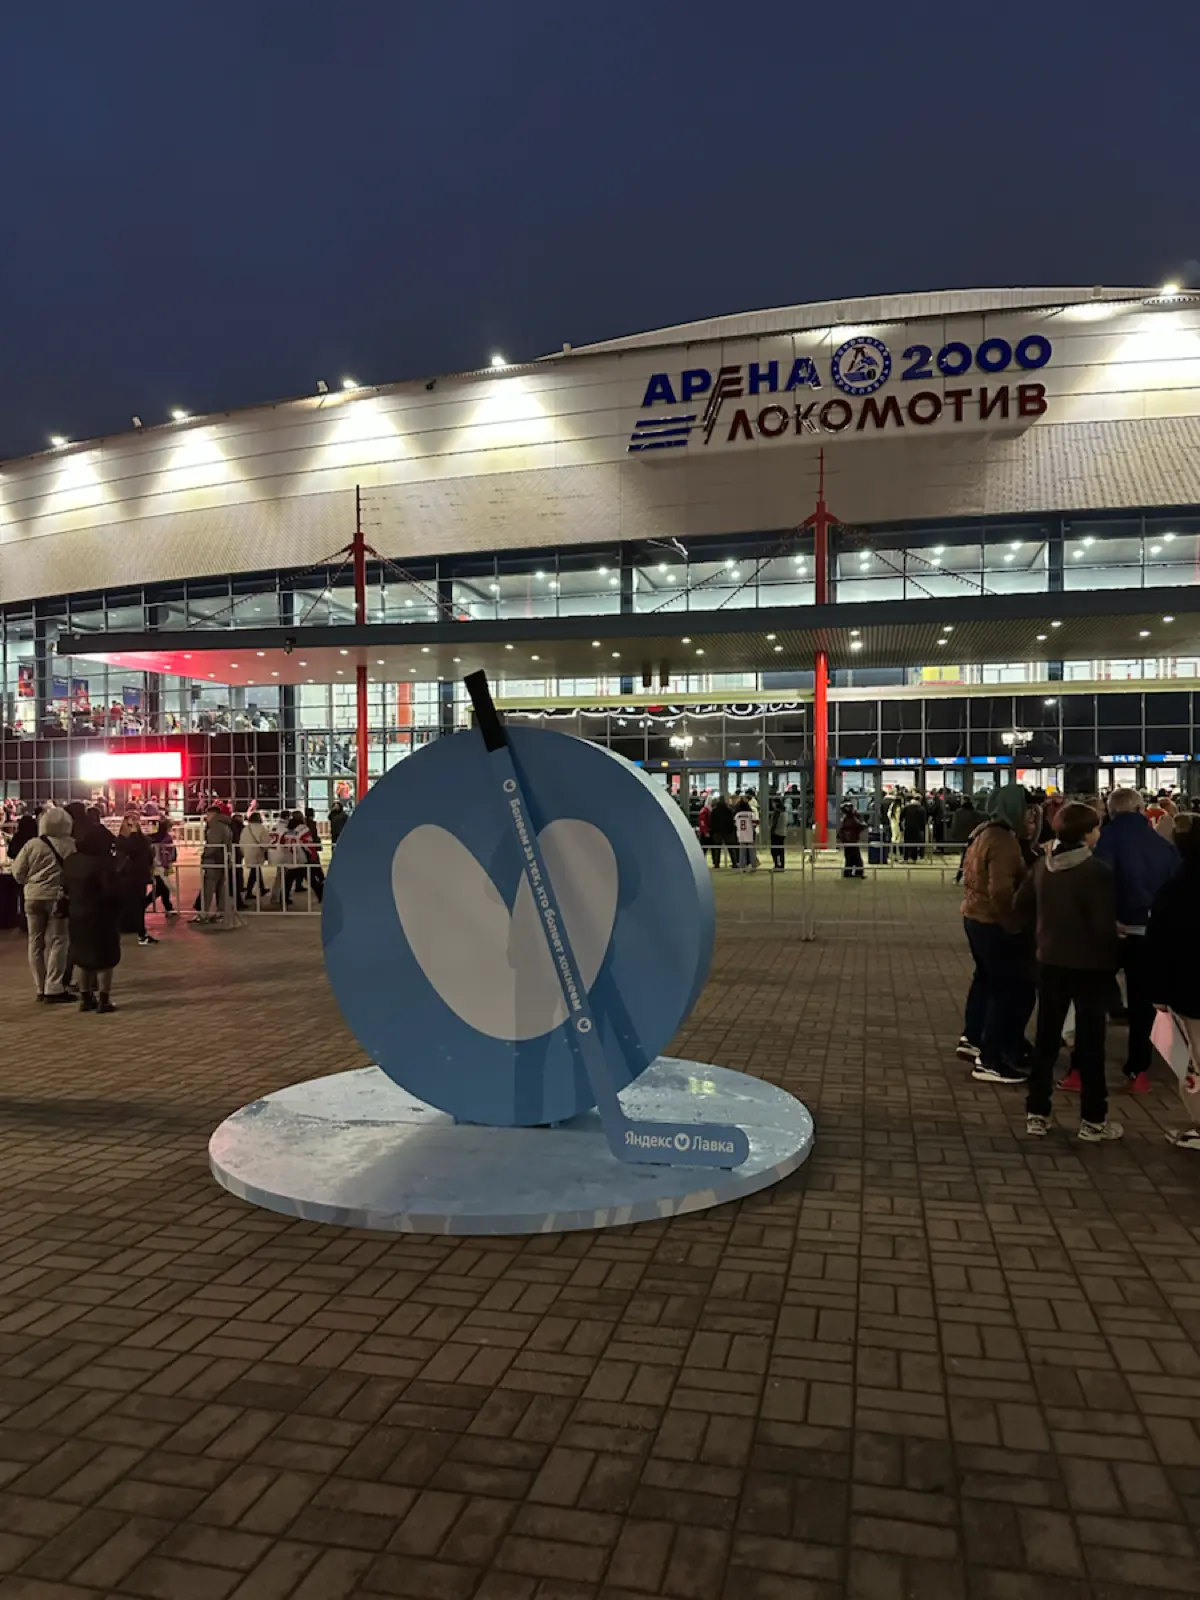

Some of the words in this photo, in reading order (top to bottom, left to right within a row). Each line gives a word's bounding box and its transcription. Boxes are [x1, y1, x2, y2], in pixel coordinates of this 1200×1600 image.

[641, 356, 823, 444] АРЕНА
[902, 335, 1052, 380] 2000
[727, 383, 1048, 442] ЛОКОМОТИВ
[508, 797, 530, 846] Болеем
[523, 845, 534, 860] за
[536, 886, 549, 909] кто
[543, 908, 564, 953] болеет
[558, 953, 582, 1012] хоккеем
[624, 1130, 673, 1149] Яндекс
[691, 1135, 734, 1153] Лавка
